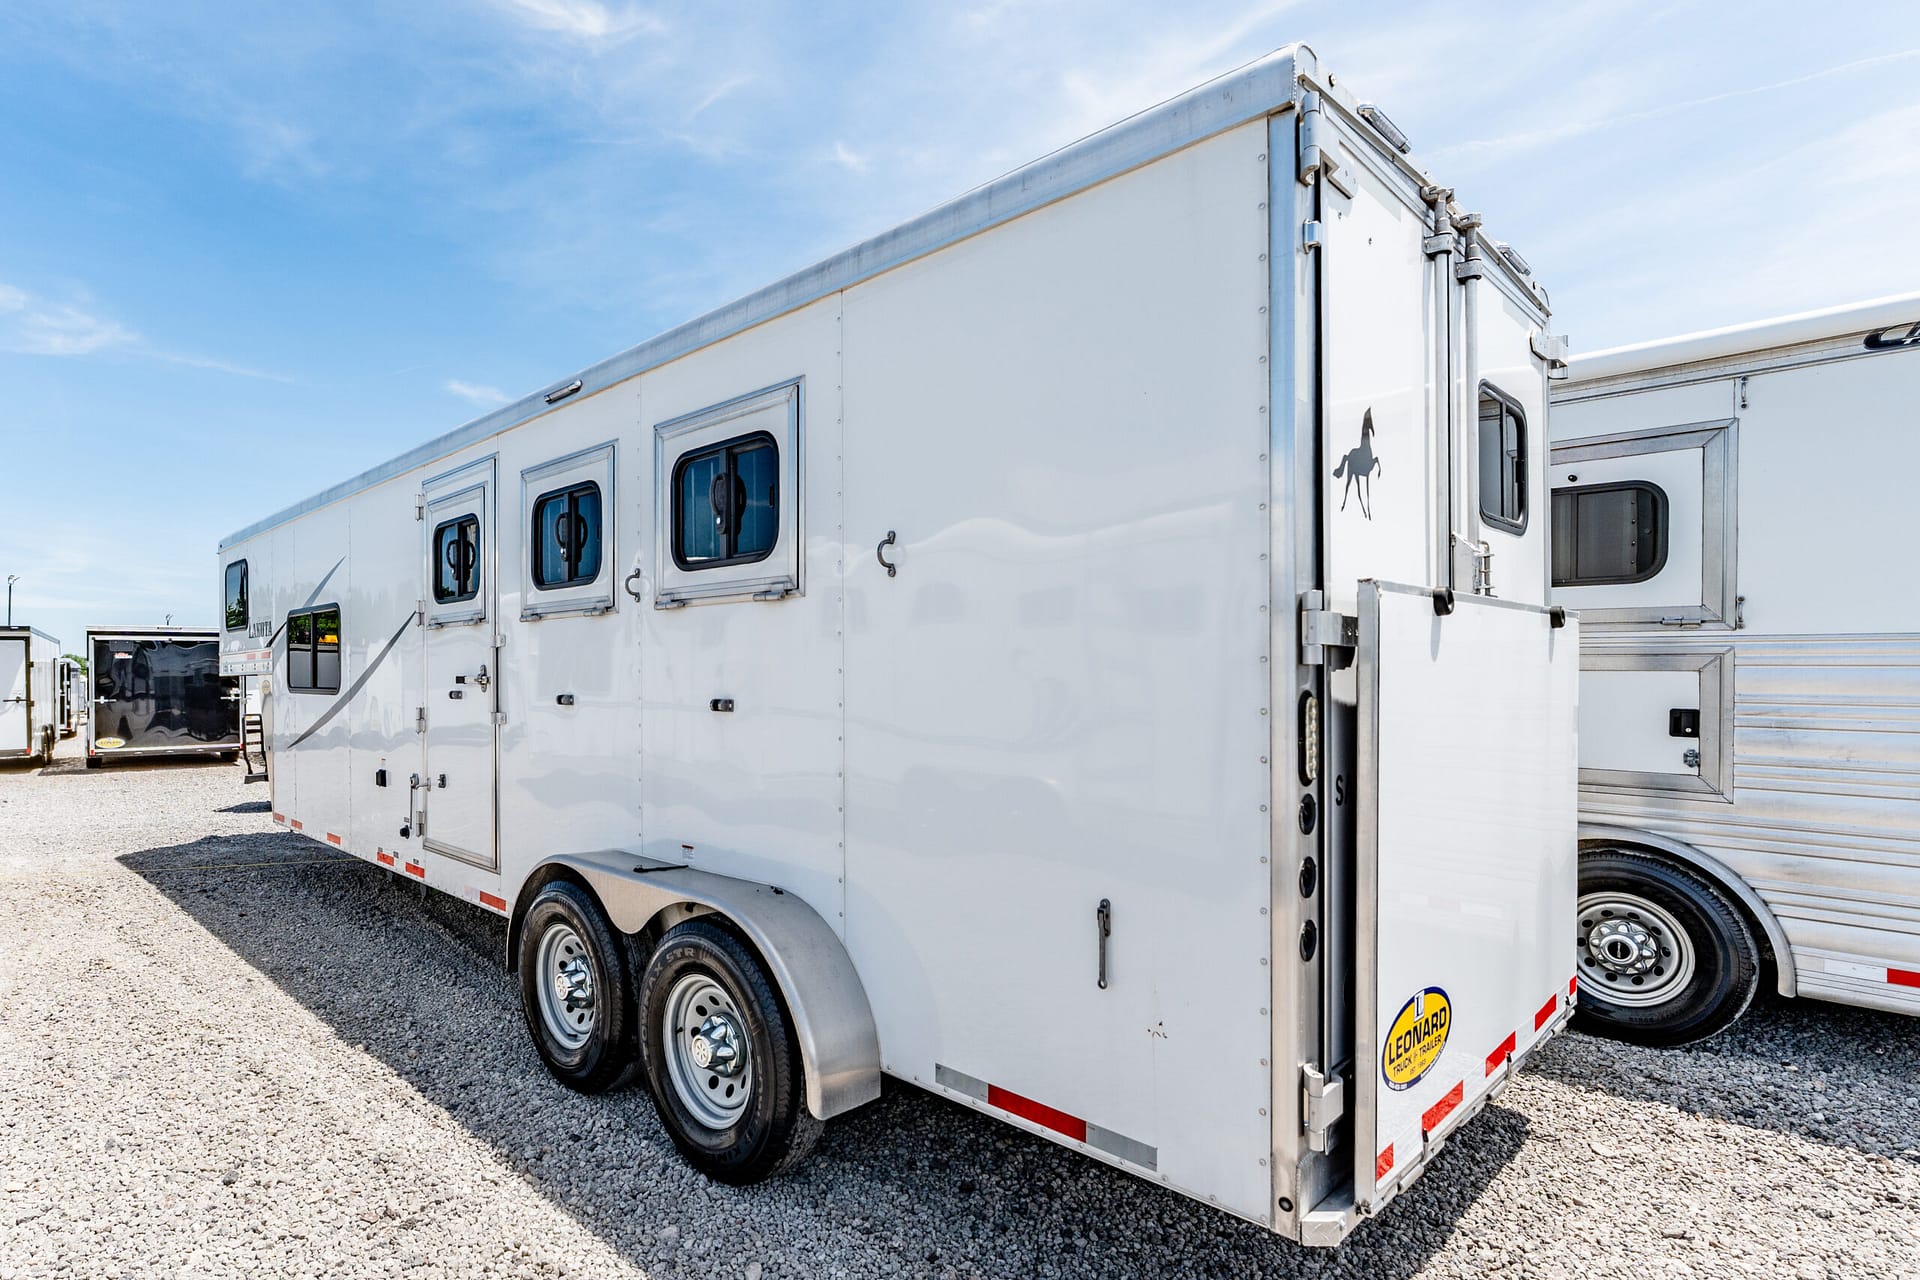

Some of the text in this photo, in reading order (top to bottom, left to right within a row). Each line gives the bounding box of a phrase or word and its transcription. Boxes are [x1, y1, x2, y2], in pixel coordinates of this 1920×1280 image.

[666, 947, 696, 963] STR
[1389, 1006, 1446, 1066] LEONARD
[1393, 1056, 1412, 1078] TRUCK
[1419, 1034, 1442, 1057] TRAILER
